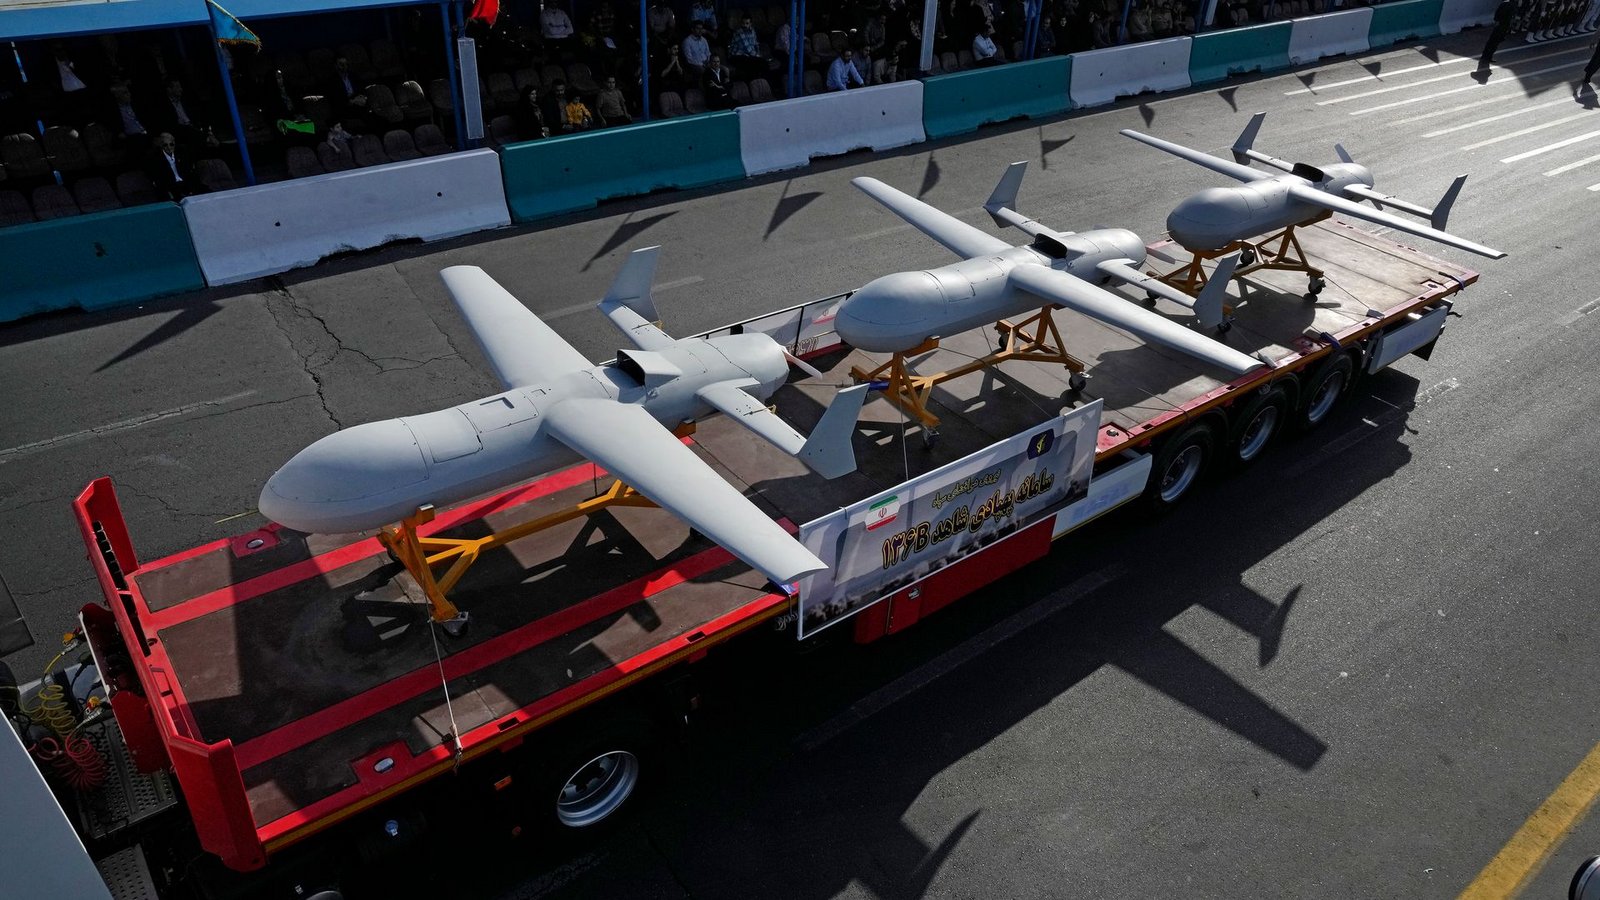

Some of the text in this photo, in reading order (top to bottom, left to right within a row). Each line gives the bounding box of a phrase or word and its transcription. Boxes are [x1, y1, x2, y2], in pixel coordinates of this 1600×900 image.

[932, 492, 947, 509] سپاه
[1015, 467, 1054, 503] سامانه
[930, 505, 970, 545] شاهد
[970, 489, 1015, 533] پهپادی
[882, 521, 930, 569] ۱۳۶B
